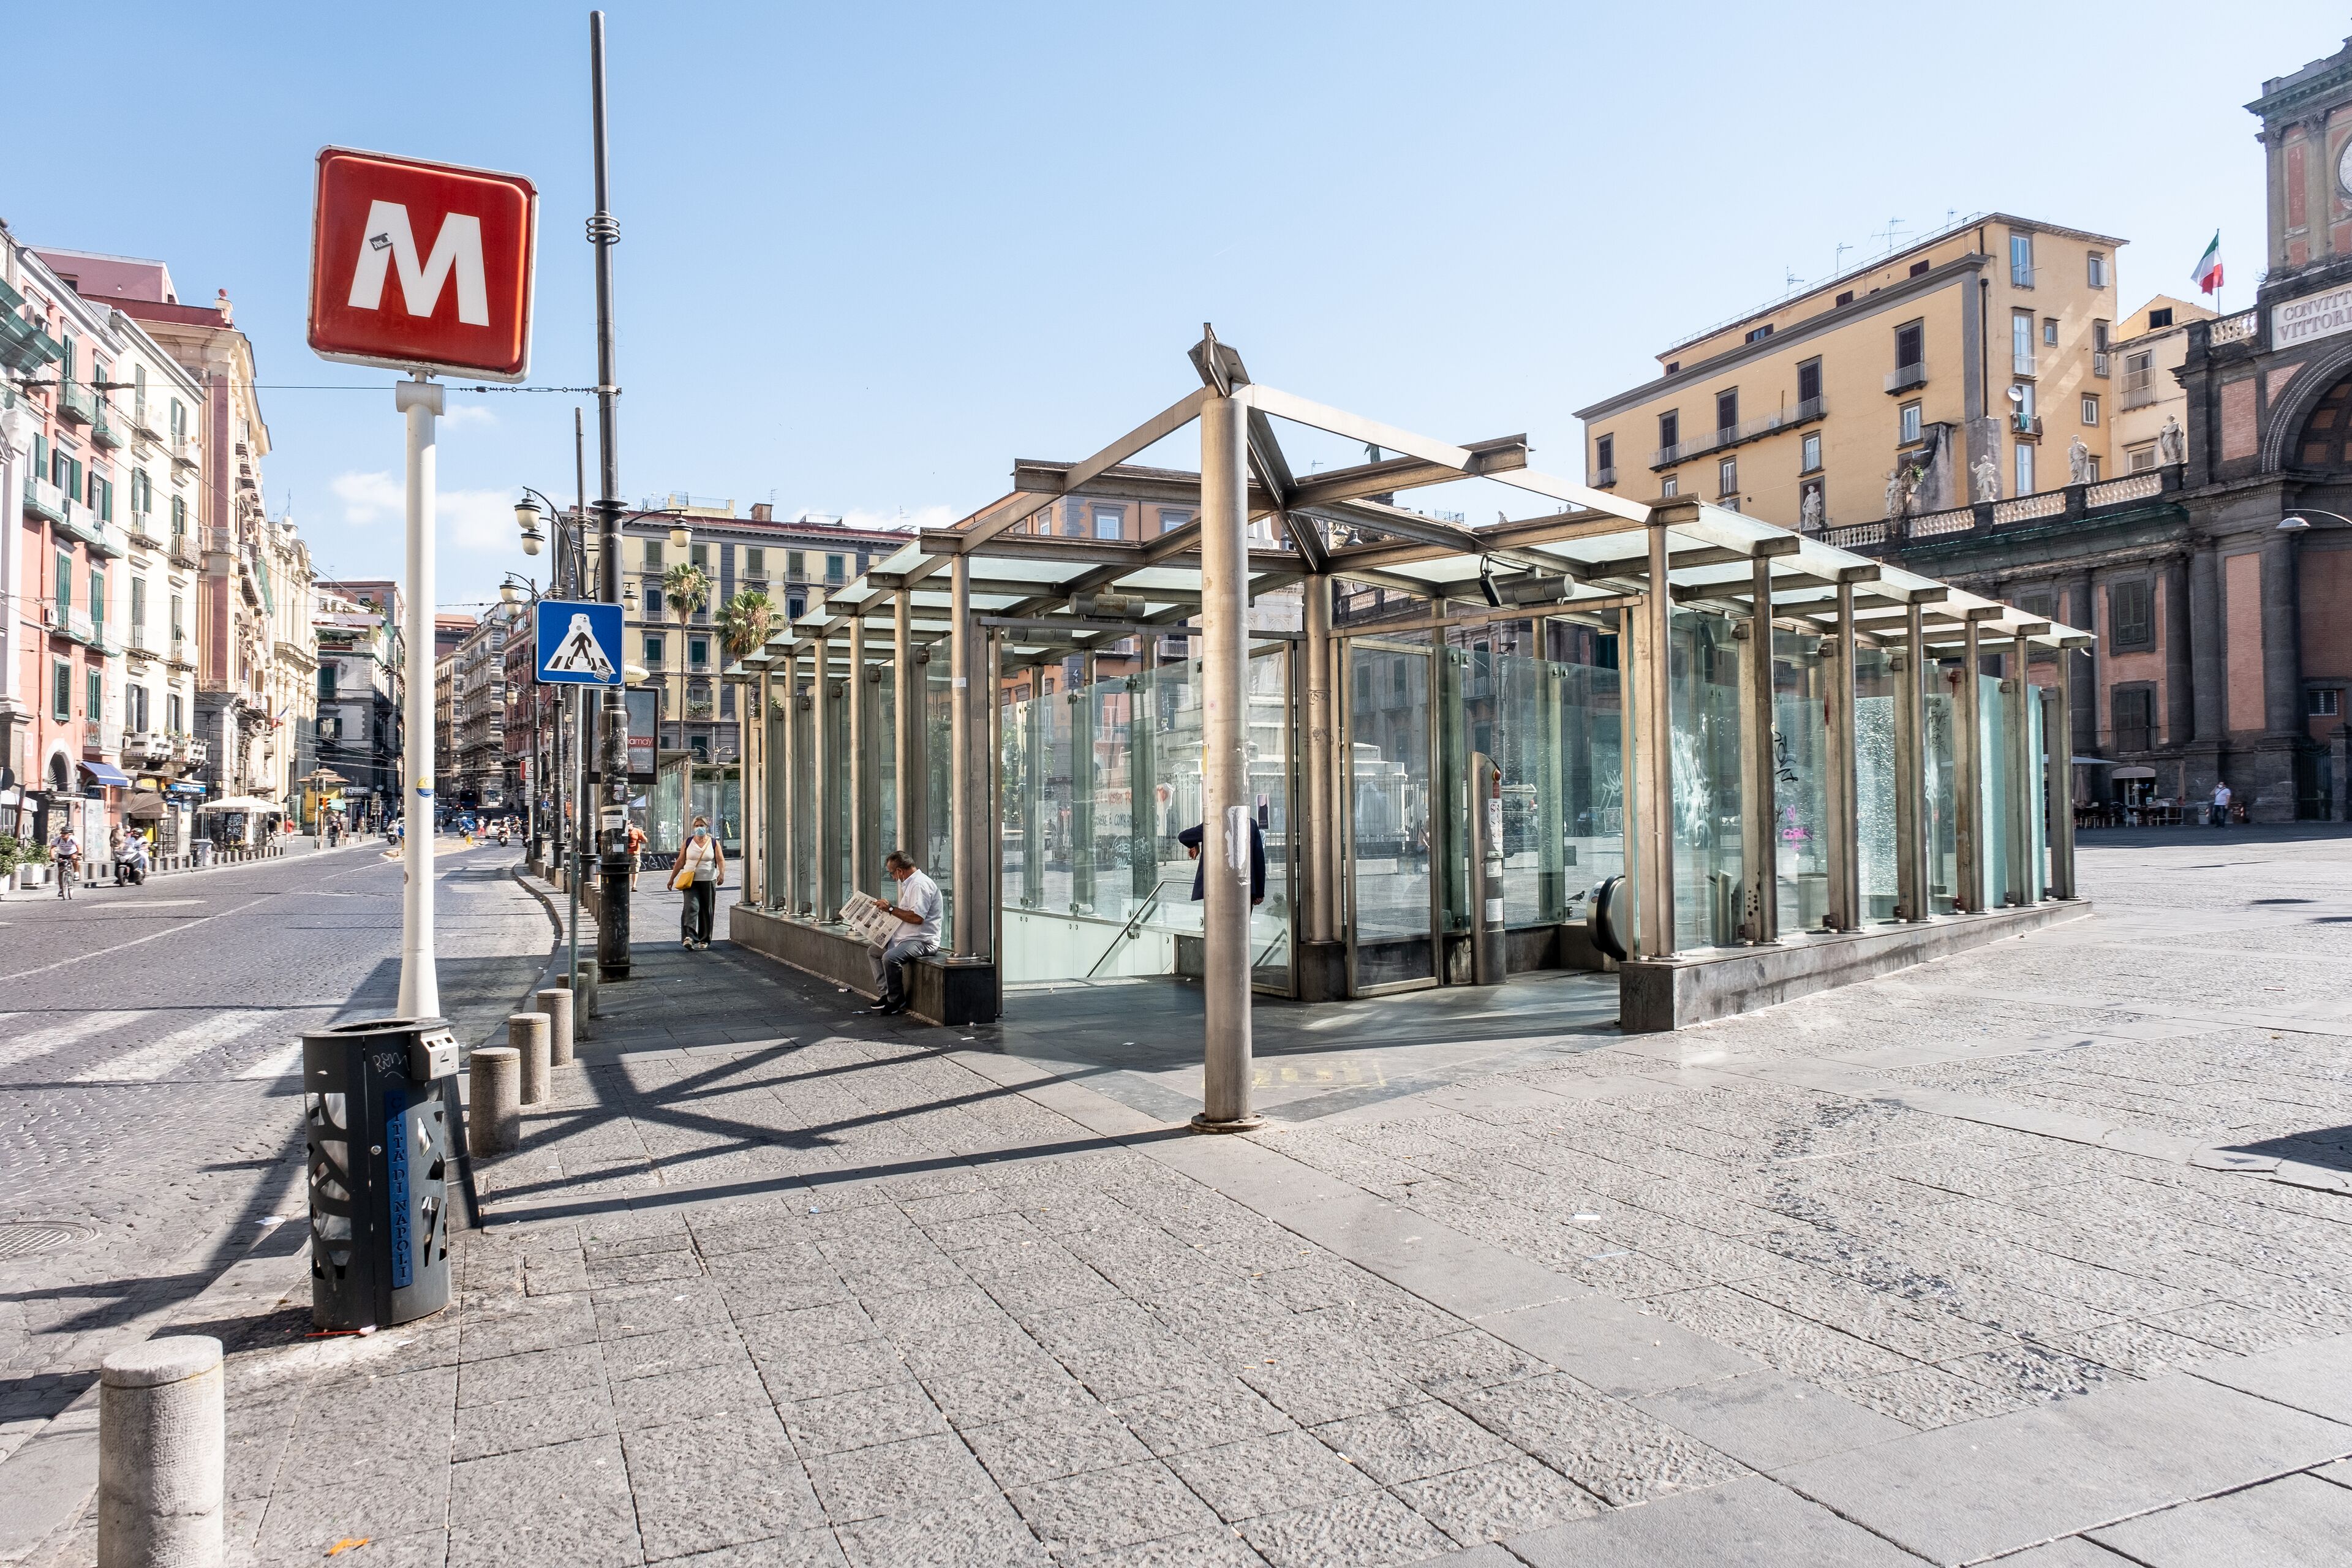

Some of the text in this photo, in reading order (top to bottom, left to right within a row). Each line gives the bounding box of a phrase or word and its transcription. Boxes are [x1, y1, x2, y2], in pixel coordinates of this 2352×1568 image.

[347, 199, 489, 326] M
[393, 1169, 405, 1194] DI
[394, 1200, 409, 1279] NAPOLI
